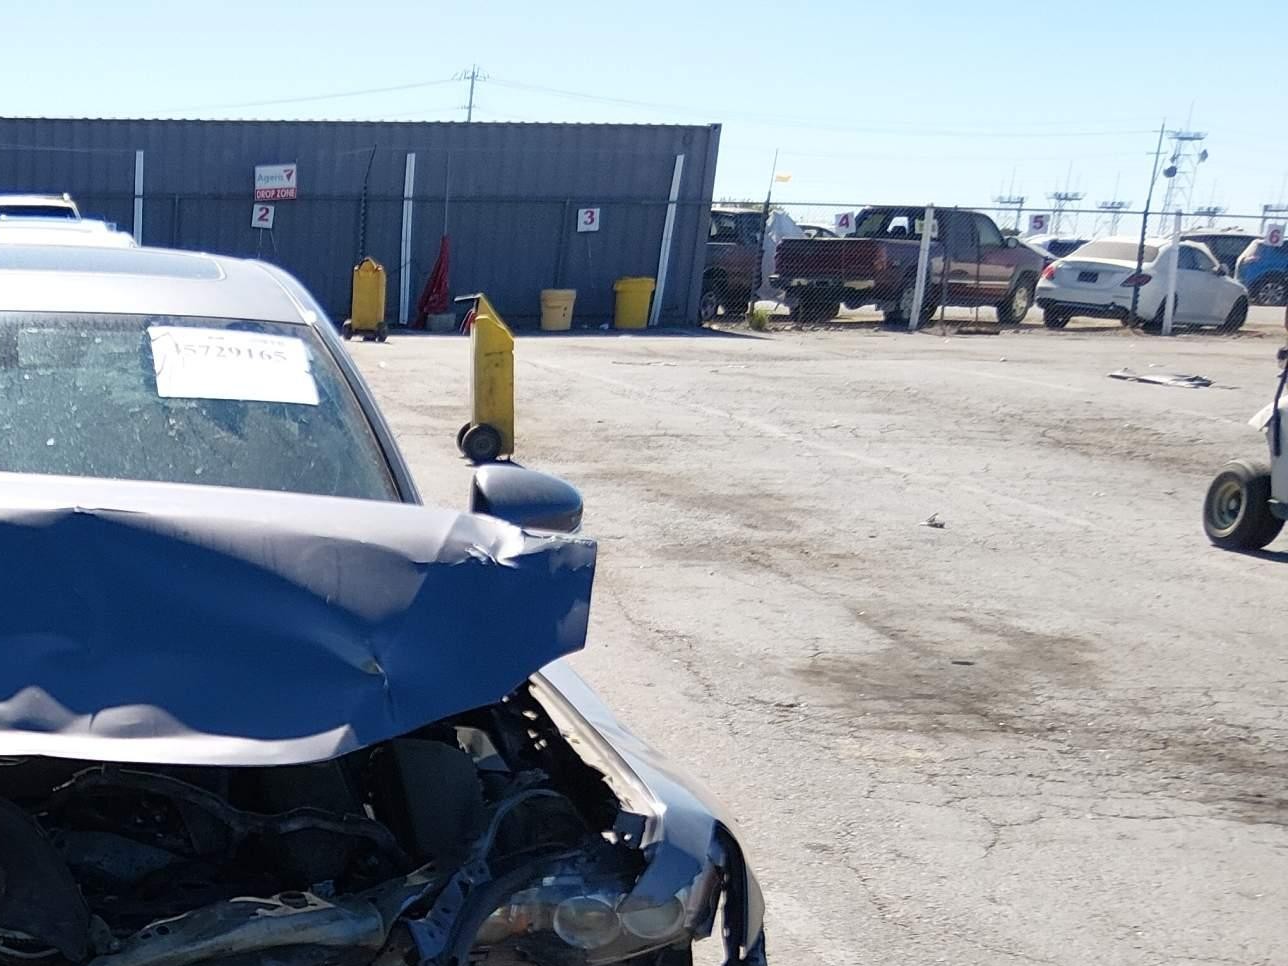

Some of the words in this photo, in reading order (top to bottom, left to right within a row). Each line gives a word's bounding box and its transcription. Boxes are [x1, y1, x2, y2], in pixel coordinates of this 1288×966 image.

[256, 189, 274, 199] DROP
[276, 188, 294, 198] ZONE
[257, 206, 270, 222] 2
[583, 210, 595, 225] 3
[838, 213, 850, 229] 4
[1032, 214, 1044, 230] 5
[1269, 229, 1281, 245] 6
